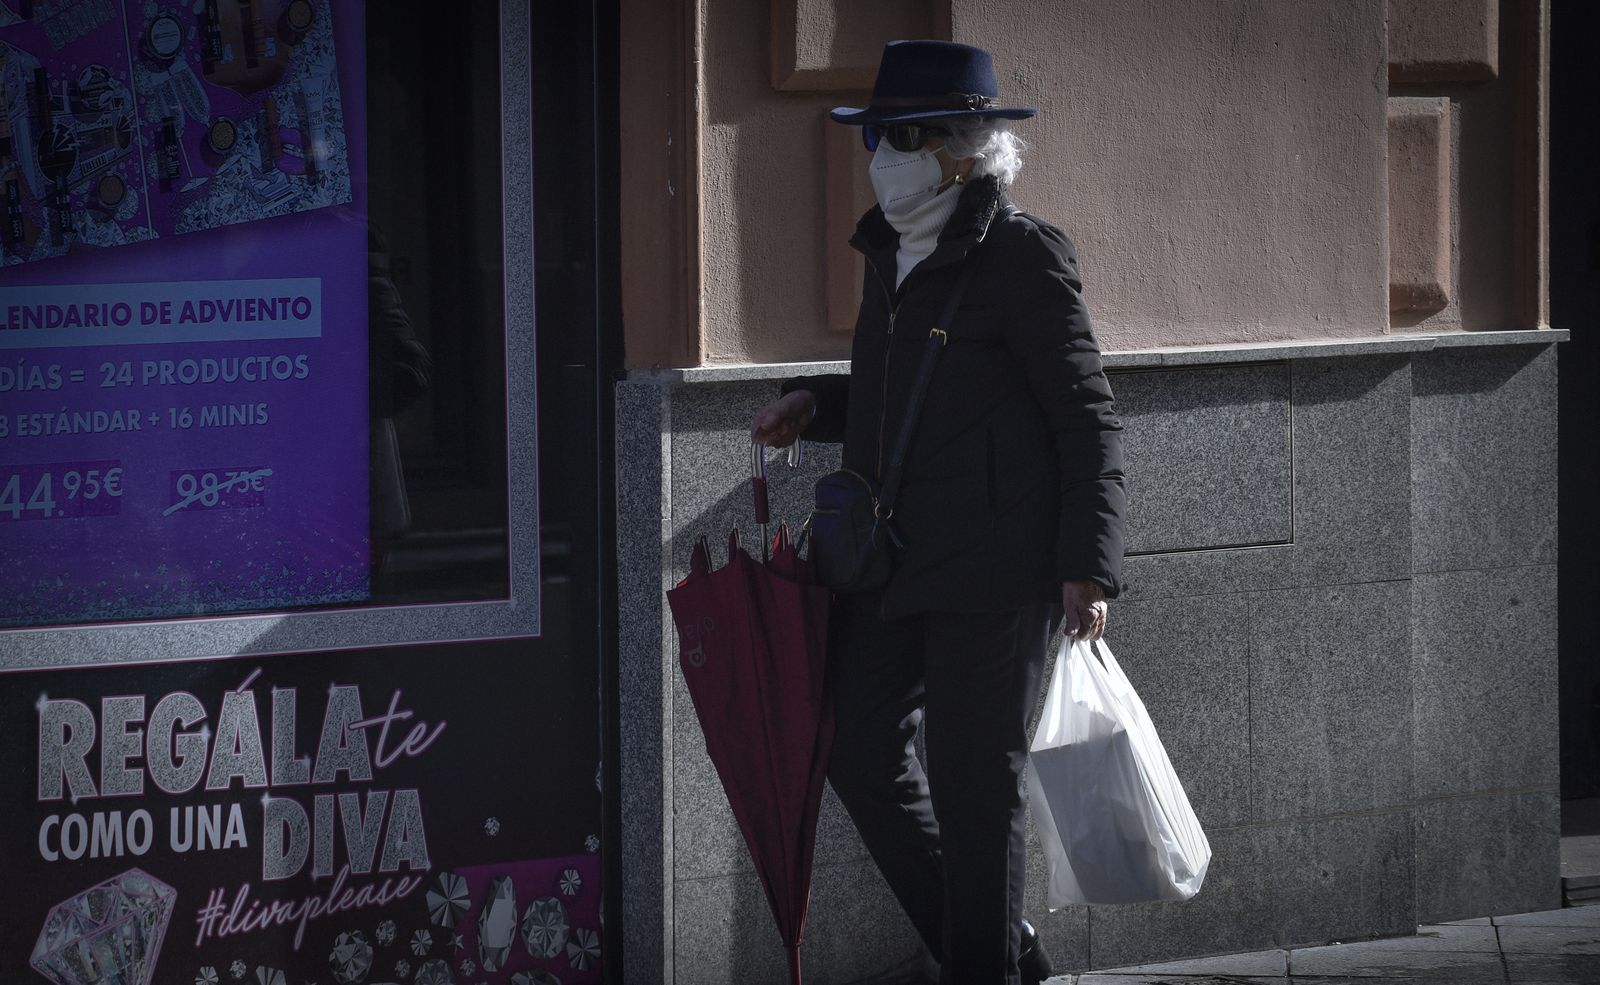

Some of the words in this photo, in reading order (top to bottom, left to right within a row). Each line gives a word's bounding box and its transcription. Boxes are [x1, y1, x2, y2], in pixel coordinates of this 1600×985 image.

[140, 301, 172, 325] DE
[179, 296, 313, 324] ADVIENTO
[0, 357, 63, 392] DÍAS
[100, 360, 134, 387] 24
[142, 354, 311, 386] PRODUCTOS
[16, 405, 142, 437] ESTÁNDAR
[168, 407, 193, 430] 16
[200, 402, 269, 427] MINIS
[38, 808, 153, 861] COMO
[169, 803, 248, 853] UNA
[262, 788, 431, 881] DIVA
[195, 864, 424, 951] #divaplease
